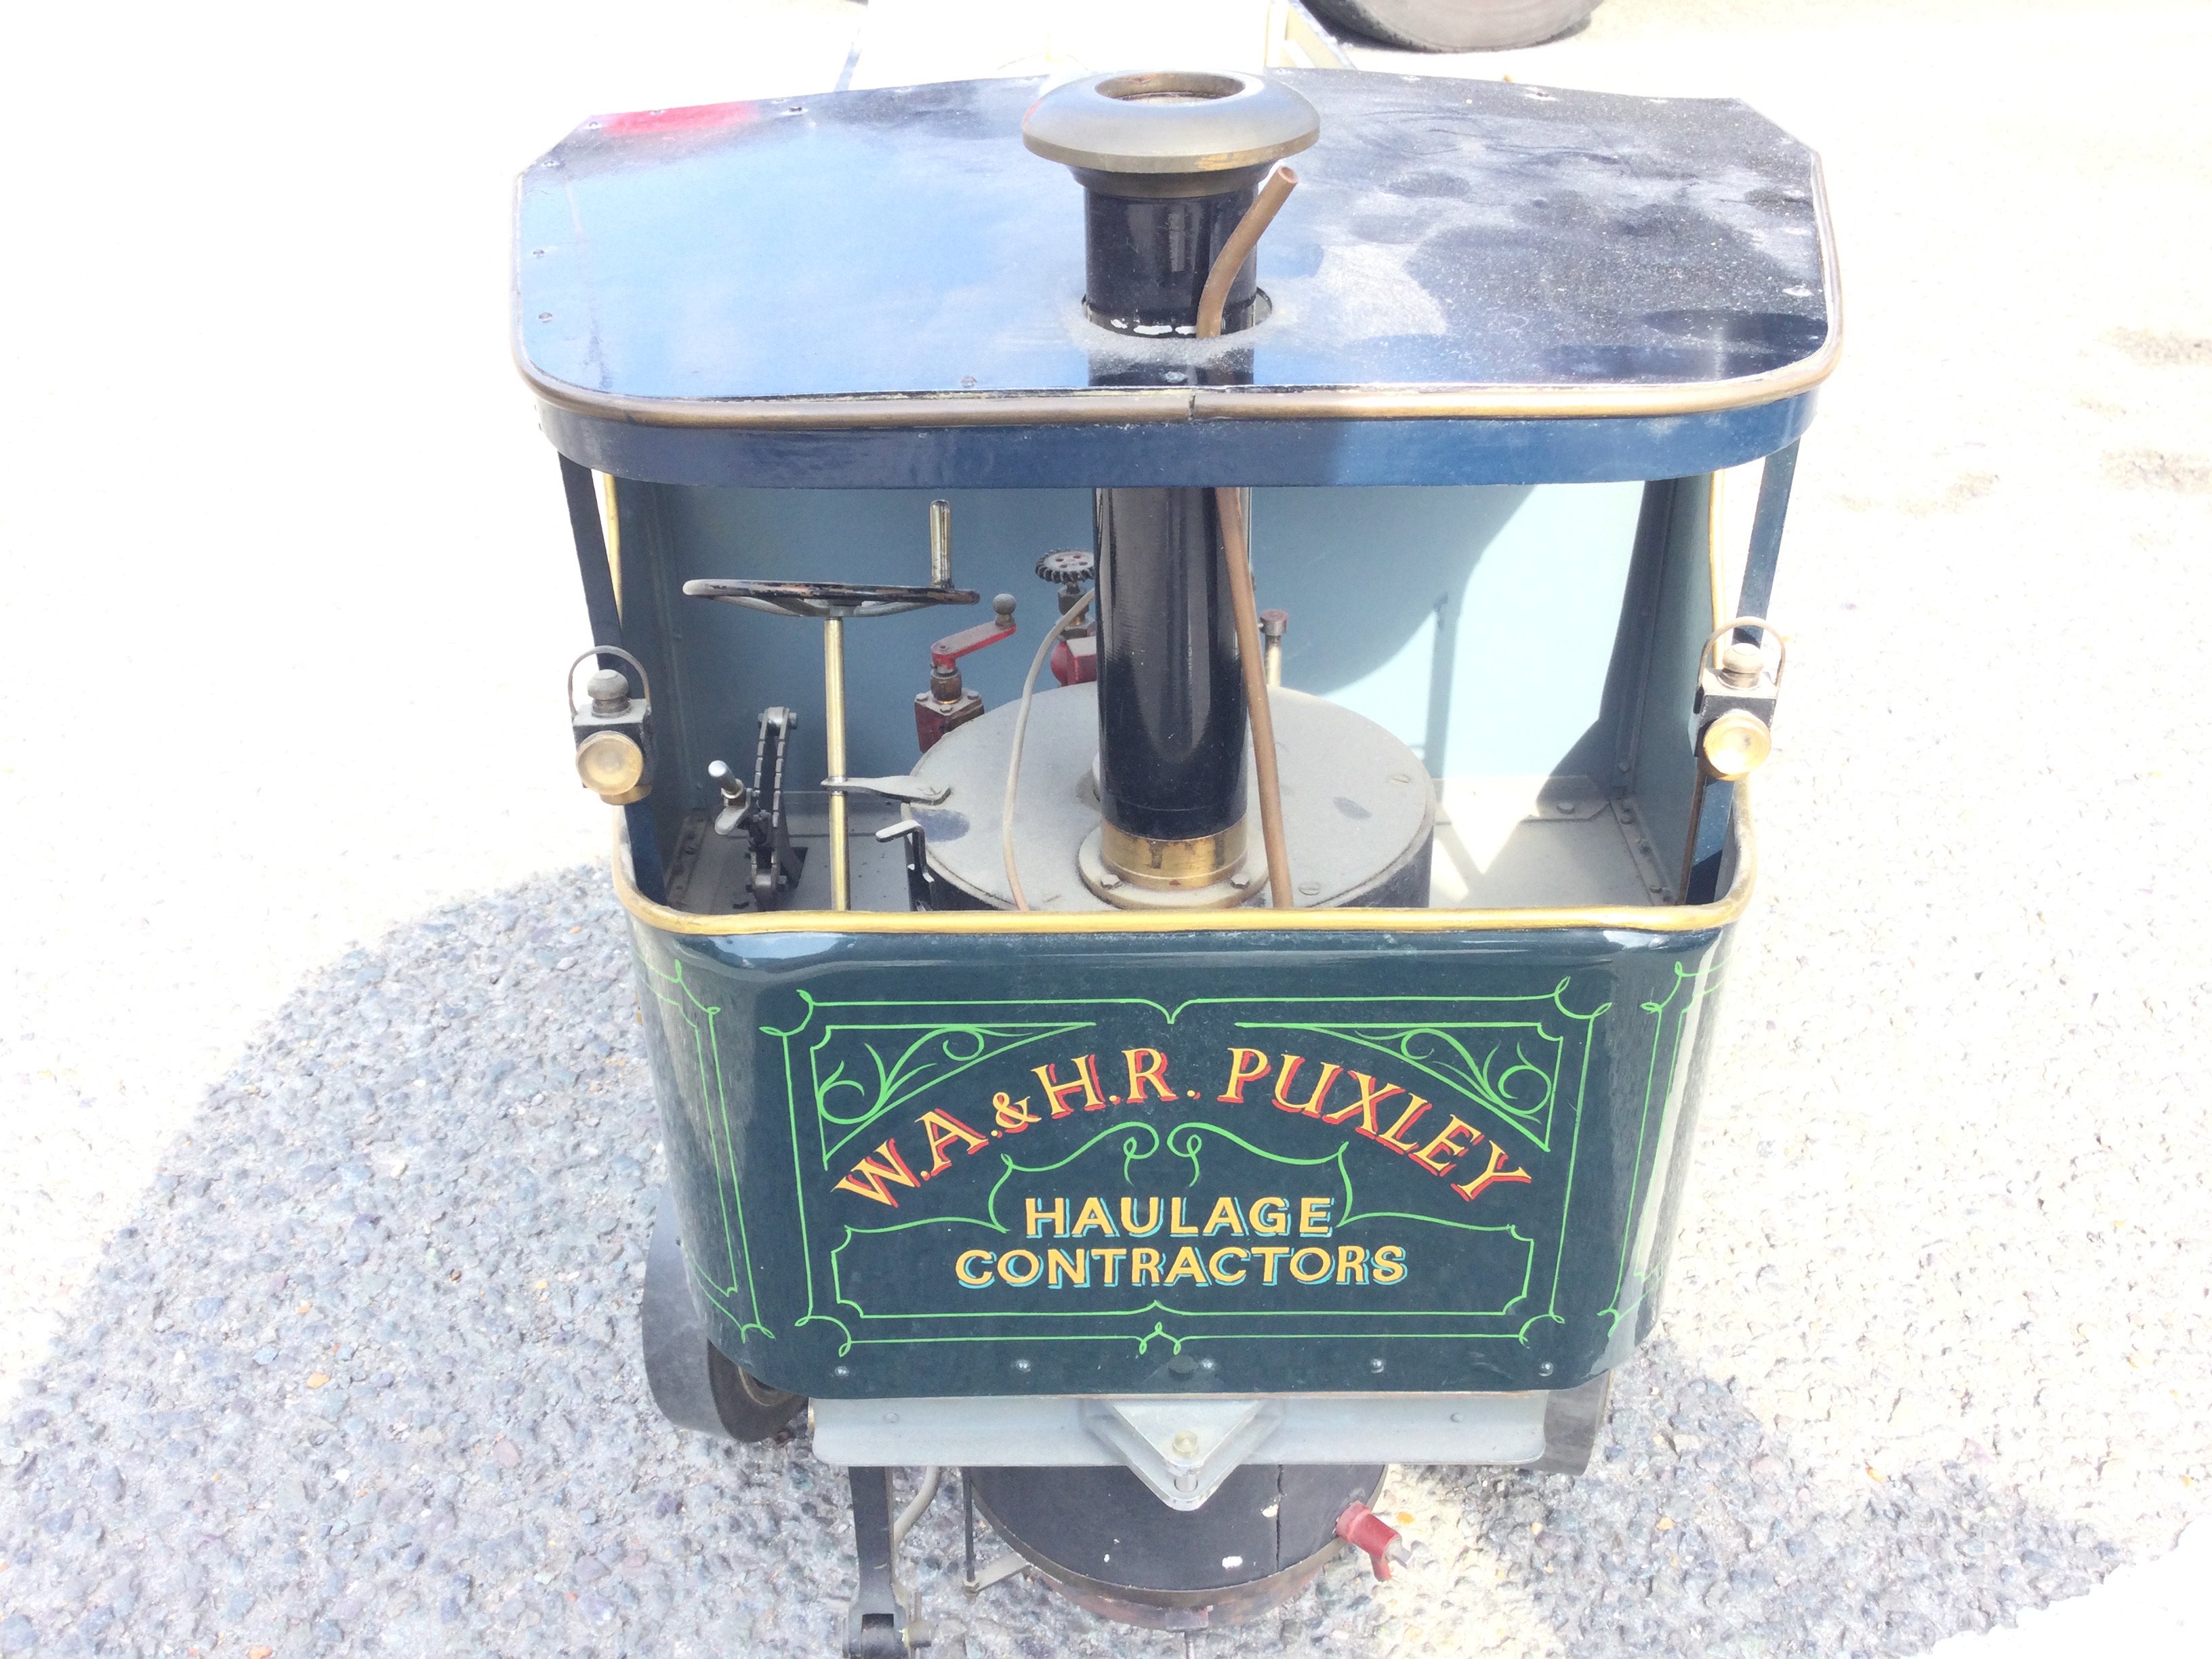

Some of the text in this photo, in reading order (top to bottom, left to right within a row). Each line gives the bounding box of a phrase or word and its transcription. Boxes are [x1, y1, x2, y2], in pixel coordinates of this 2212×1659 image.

[1217, 1048, 1532, 1202] PUXLEY
[1025, 1195, 1334, 1238] HAULAGE
[956, 1246, 1410, 1291] CONTRACTORS
